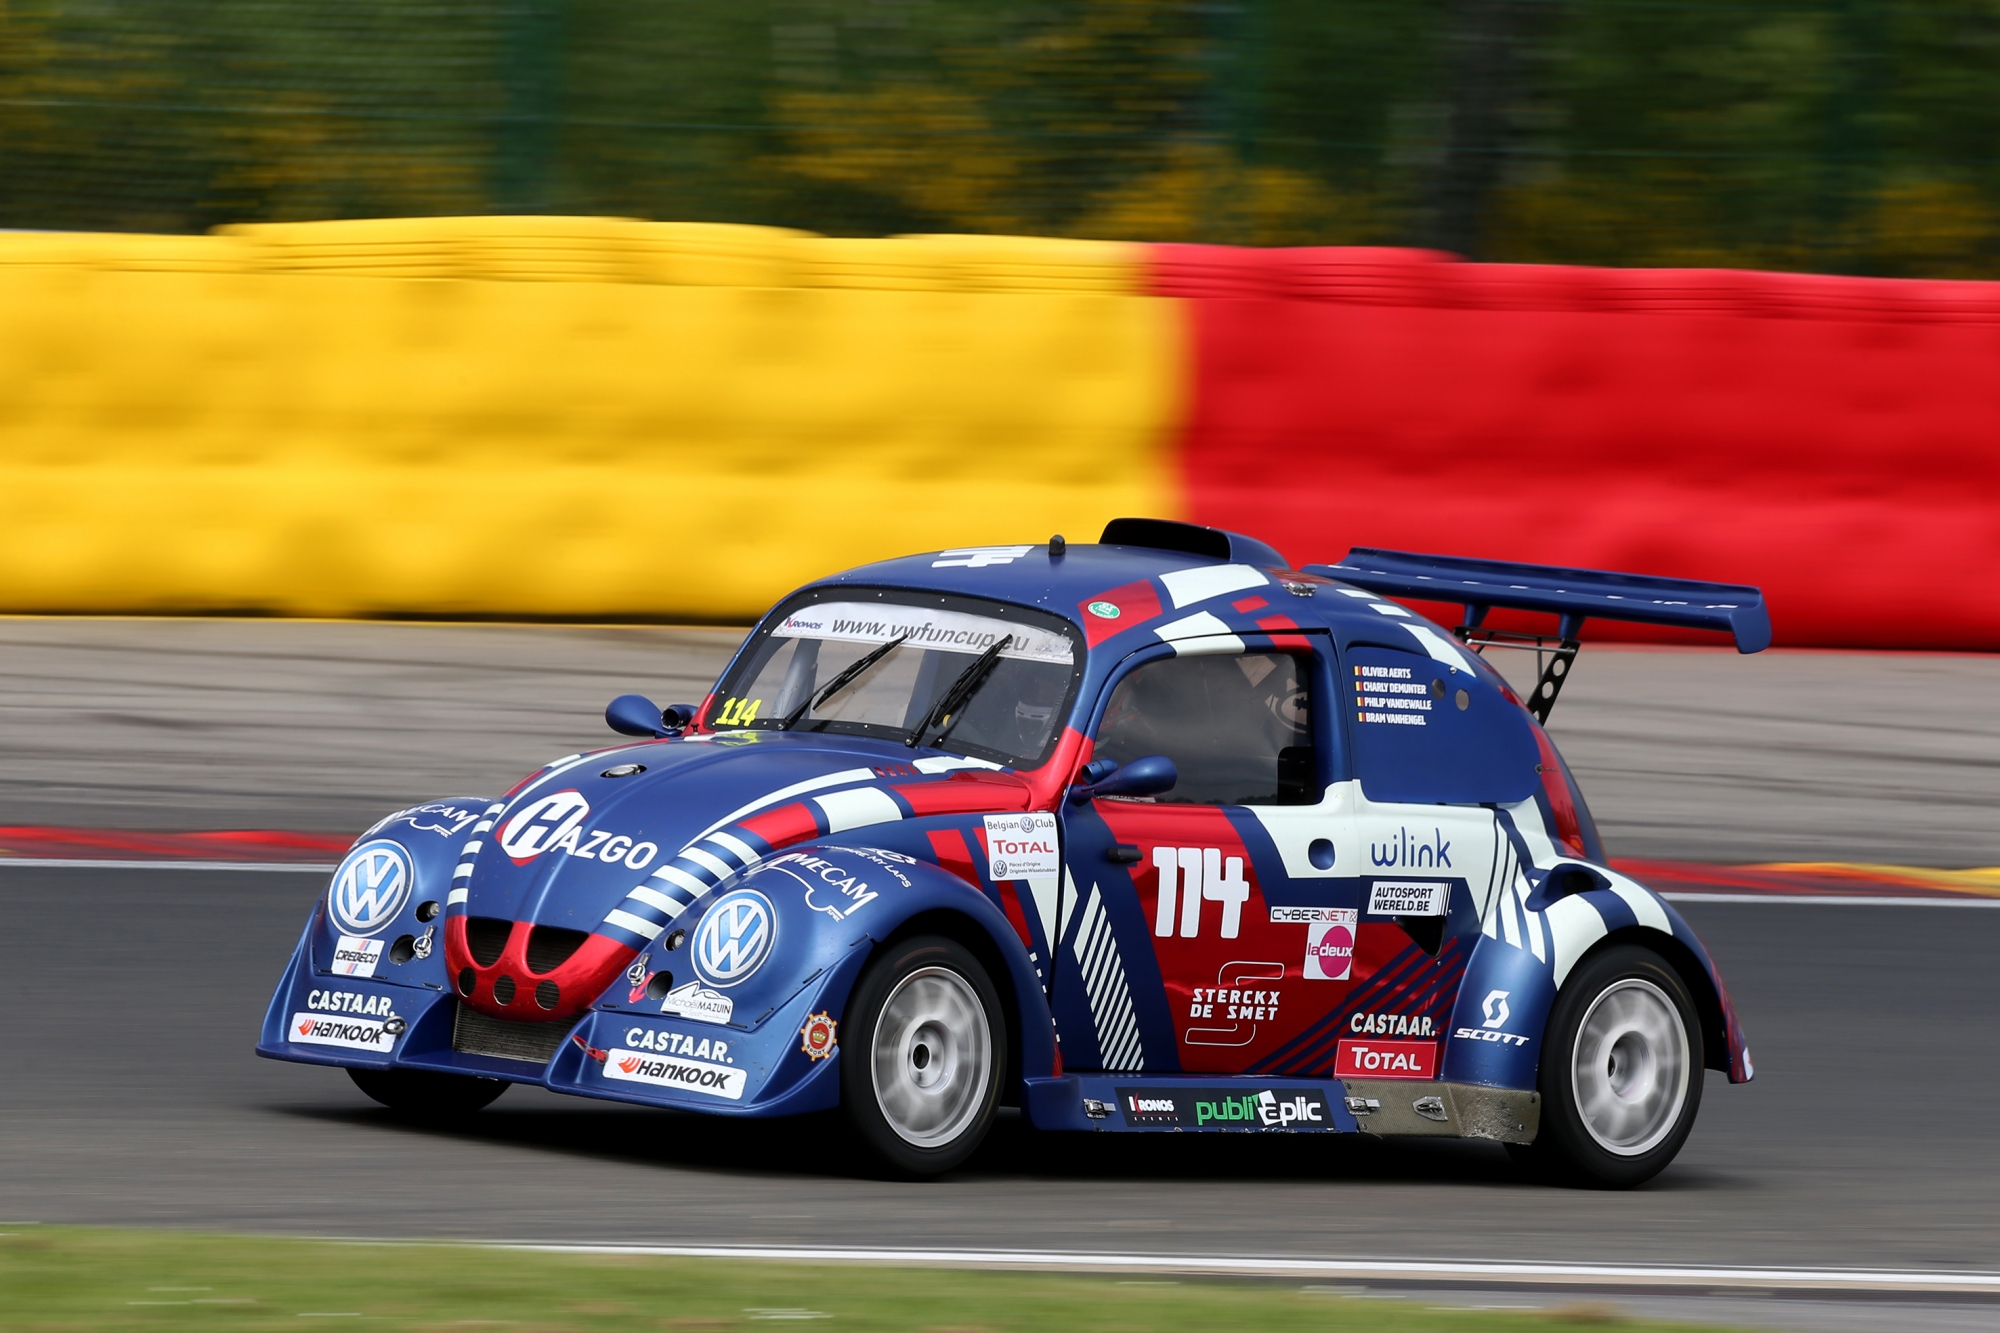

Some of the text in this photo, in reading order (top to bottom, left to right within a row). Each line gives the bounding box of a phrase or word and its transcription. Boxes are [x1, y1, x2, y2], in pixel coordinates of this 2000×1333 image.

[1362, 666, 1411, 679] OLIVIER AERTS
[1363, 681, 1427, 694] CHARLY DEMUNTER
[1364, 697, 1432, 710] PHILIP VANDEWALLE
[715, 697, 762, 727] 114
[1365, 712, 1426, 725] BRAM VANHENGEL
[987, 821, 1020, 832] Belgian
[1035, 819, 1054, 829] Club
[504, 798, 658, 870] HAZGO
[993, 839, 1054, 855] TOTAL
[884, 865, 912, 888] LAPS
[1152, 847, 1250, 939] 114
[1375, 887, 1434, 899] AUTOSPORT
[1374, 900, 1430, 912] WERELD.BE
[336, 949, 378, 963] CREDECO
[1192, 988, 1280, 1005] STERCKX
[698, 1001, 732, 1015] MAZUIN
[1189, 1003, 1278, 1020] DE SMET
[1453, 1027, 1530, 1046] SCOTT
[806, 1044, 825, 1055] SPORT
[1351, 1046, 1422, 1071] TOTAL
[1128, 1092, 1175, 1112] KRONOS
